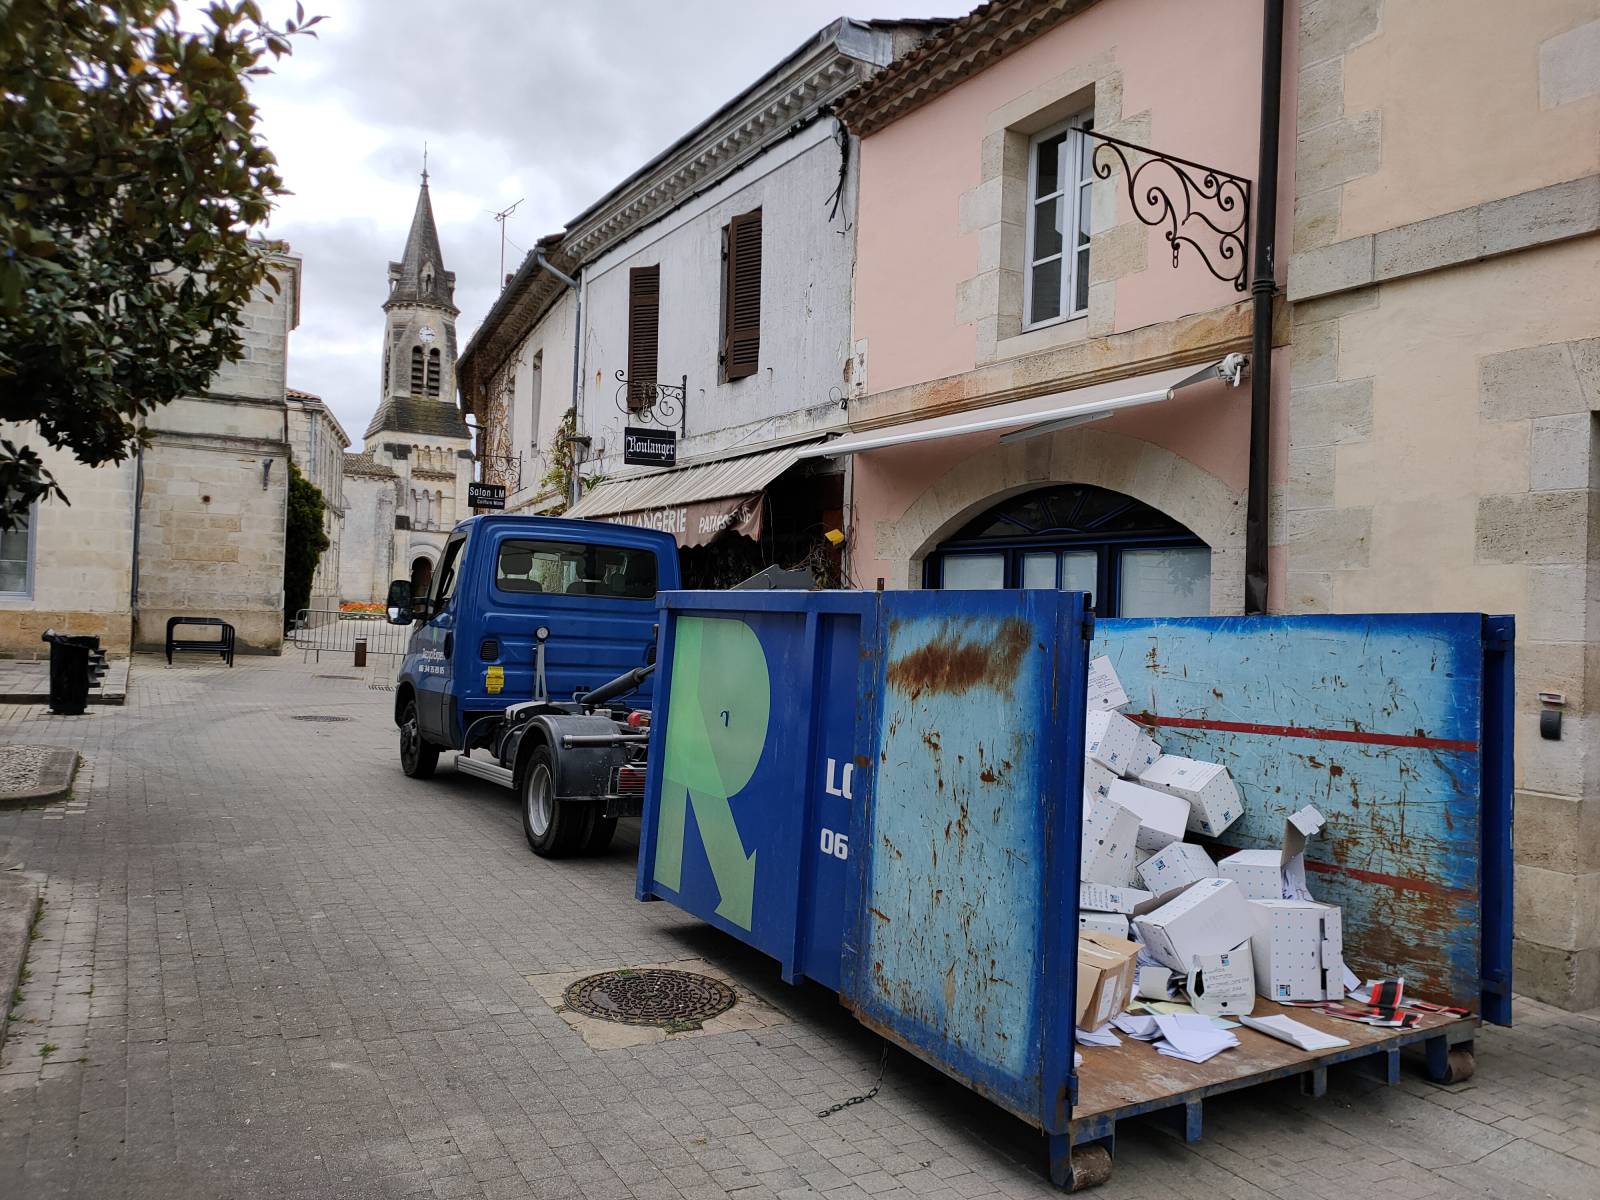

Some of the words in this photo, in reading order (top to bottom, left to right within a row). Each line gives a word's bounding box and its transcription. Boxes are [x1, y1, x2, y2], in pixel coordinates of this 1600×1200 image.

[627, 436, 674, 460] Boulanger
[470, 487, 491, 497] Salon
[494, 489, 505, 498] LM
[820, 827, 849, 860] 06
